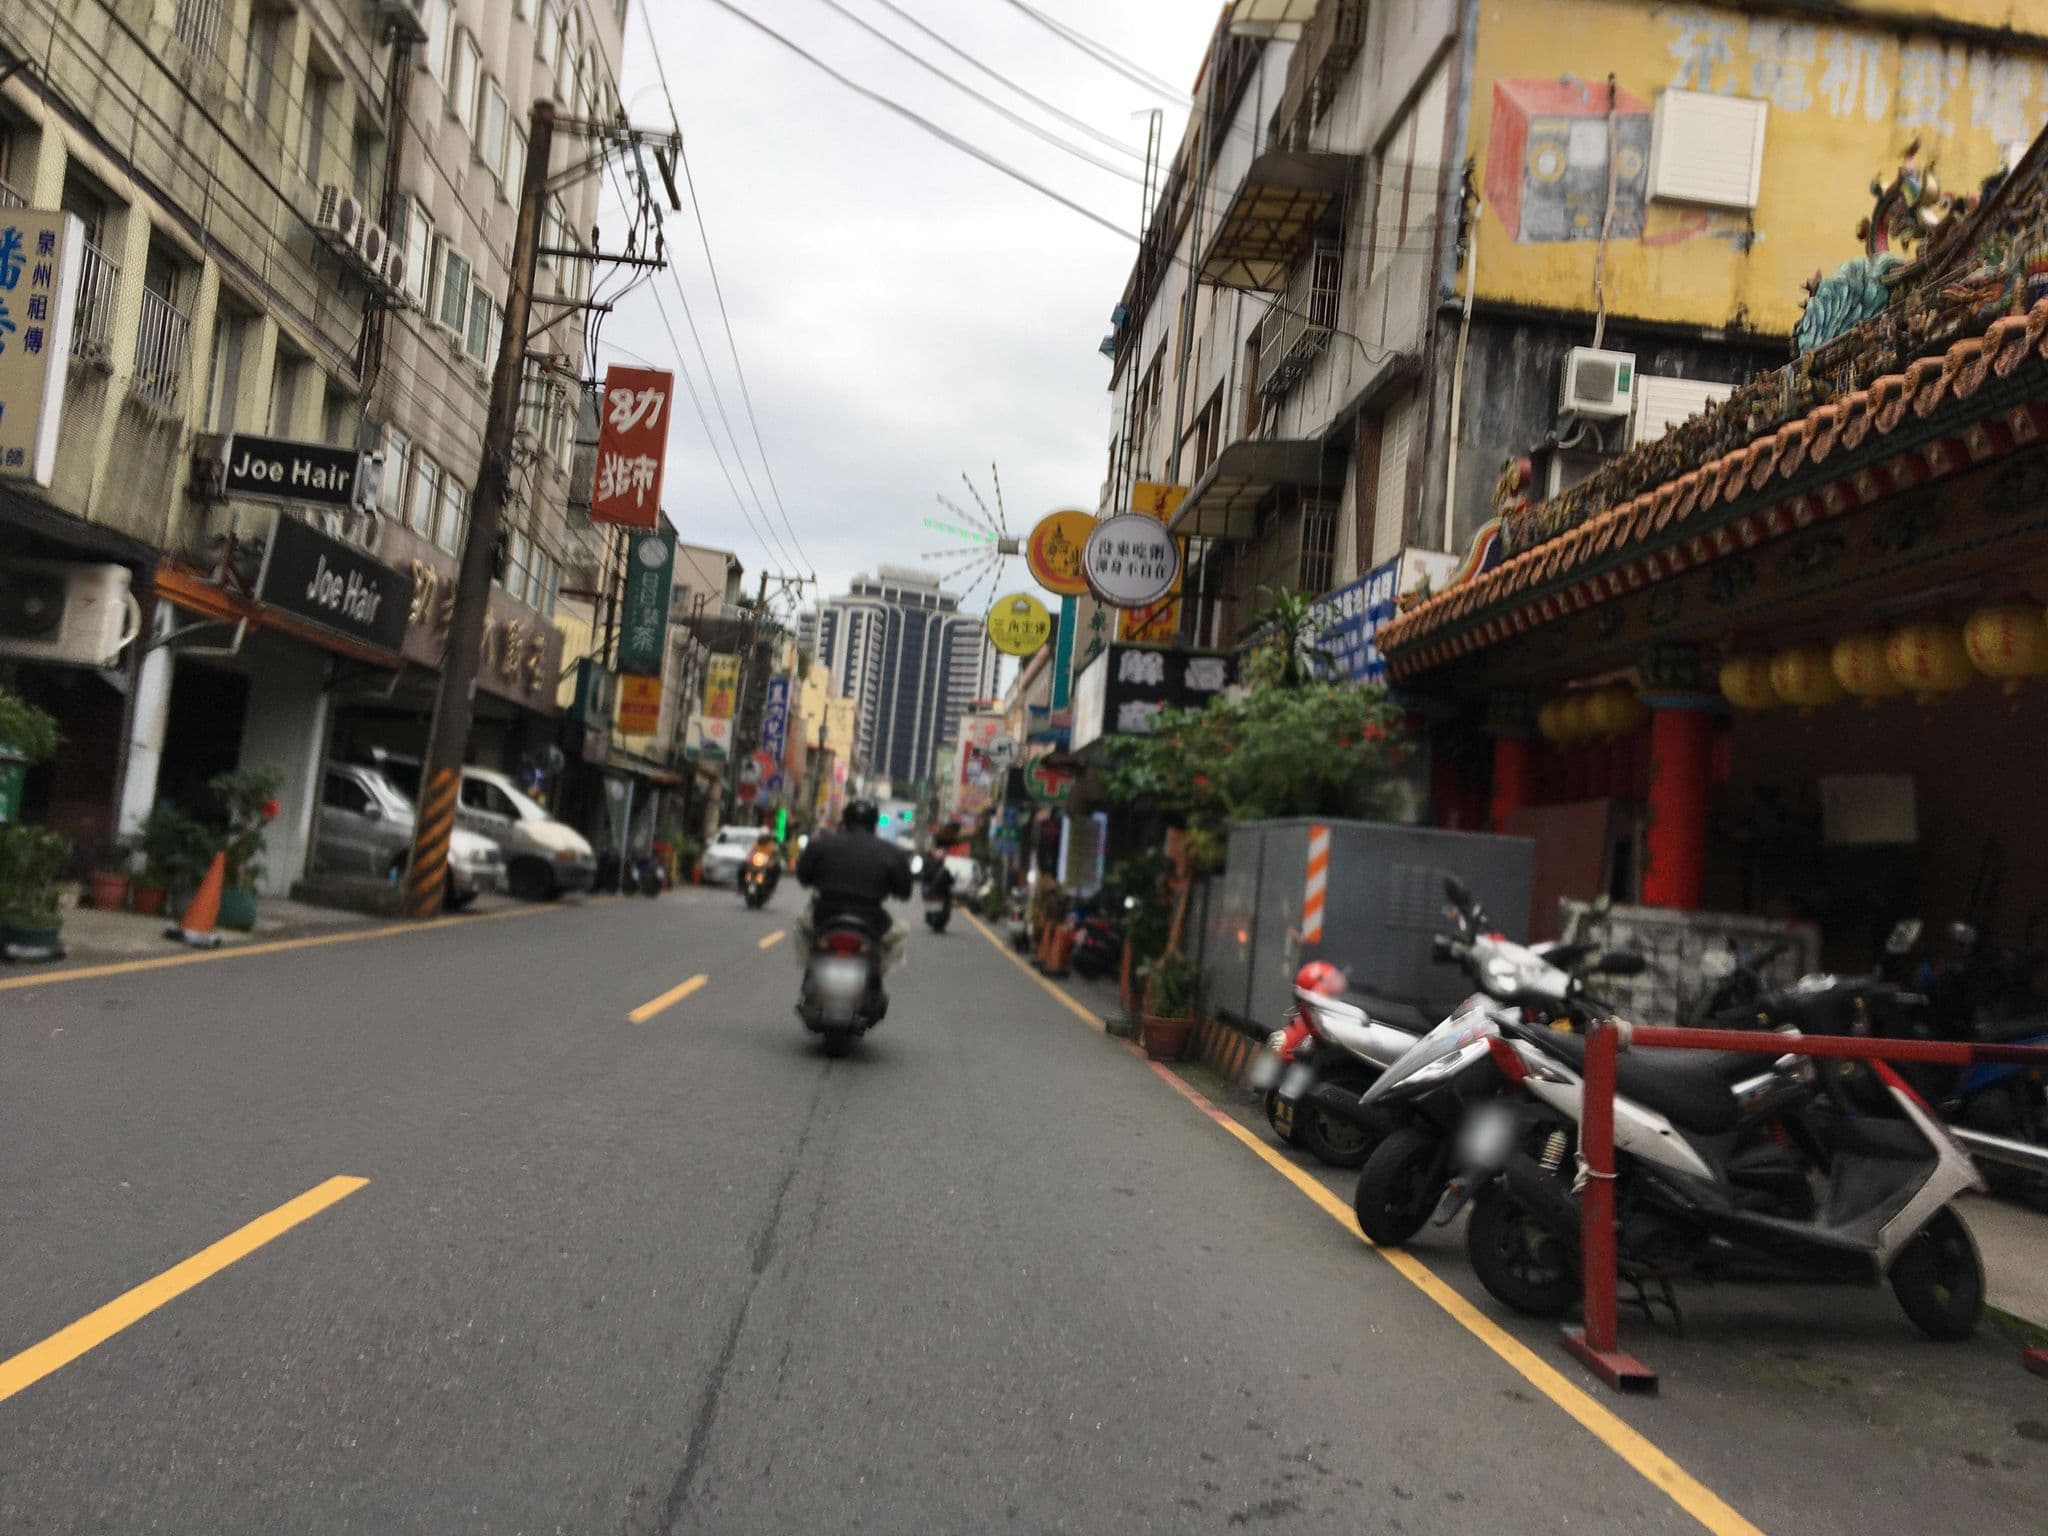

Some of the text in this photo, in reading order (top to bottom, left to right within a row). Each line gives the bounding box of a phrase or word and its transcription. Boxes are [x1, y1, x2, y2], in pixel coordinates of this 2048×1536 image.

[23, 230, 56, 355] 泉州祖傳
[233, 452, 350, 492] Joe Hair
[598, 386, 666, 508] 幼獅
[306, 554, 382, 625] Joe Hair
